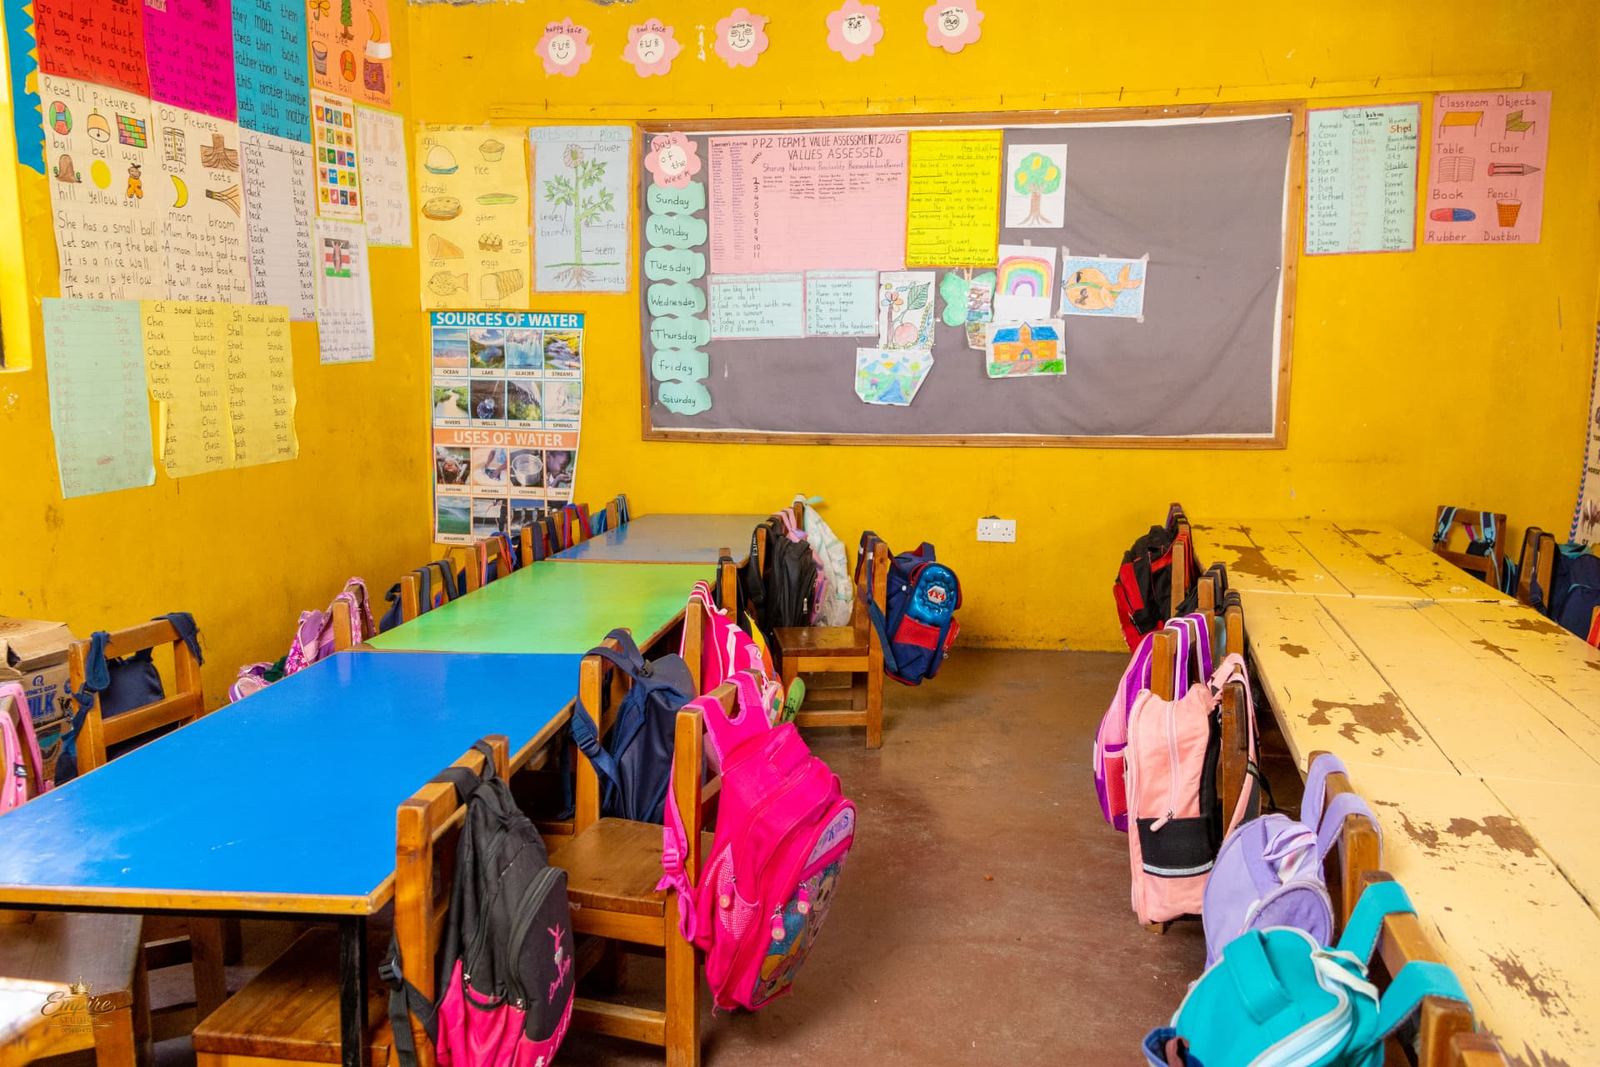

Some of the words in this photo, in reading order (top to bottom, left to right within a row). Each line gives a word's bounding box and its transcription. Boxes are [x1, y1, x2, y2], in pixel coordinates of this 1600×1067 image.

[44, 76, 71, 98] Read
[94, 91, 137, 114] Pictures
[1439, 95, 1489, 109] Classroom
[1497, 94, 1537, 109] Objects
[1391, 124, 1412, 133] Shed
[53, 133, 73, 152] ball
[878, 132, 904, 145] 2026
[91, 139, 113, 159] bell
[788, 148, 824, 161] VALUES
[828, 147, 884, 160] ASSESSED
[1436, 142, 1464, 155] Table
[1489, 142, 1520, 154] Chair
[121, 150, 145, 164] wall
[57, 183, 76, 201] hill
[1432, 188, 1464, 200] Book
[1487, 187, 1518, 200] Pencil
[655, 193, 690, 209] Sunday
[58, 209, 77, 230] She
[82, 214, 98, 232] has
[112, 218, 136, 234] small
[139, 219, 156, 236] ball
[169, 210, 194, 224] moon
[654, 223, 689, 240] Monday
[1428, 231, 1467, 242] Rubber
[1483, 230, 1521, 241] Dustbin
[61, 230, 77, 248] Let
[105, 240, 123, 256] ring
[126, 236, 142, 252] the
[144, 239, 159, 252] bell
[104, 256, 126, 268] nice
[129, 255, 150, 270] wall
[649, 260, 691, 274] Tuesday
[64, 268, 78, 283] The
[84, 274, 102, 284] sun
[65, 284, 84, 300] This
[110, 285, 126, 301] hill
[650, 297, 696, 309] Wednesday
[436, 312, 503, 326] SOURCES
[506, 313, 526, 326] OF
[528, 314, 579, 328] WATER
[654, 328, 698, 344] Thursday
[454, 431, 490, 445] USES
[492, 431, 513, 444] OF
[513, 432, 563, 446] WATER
